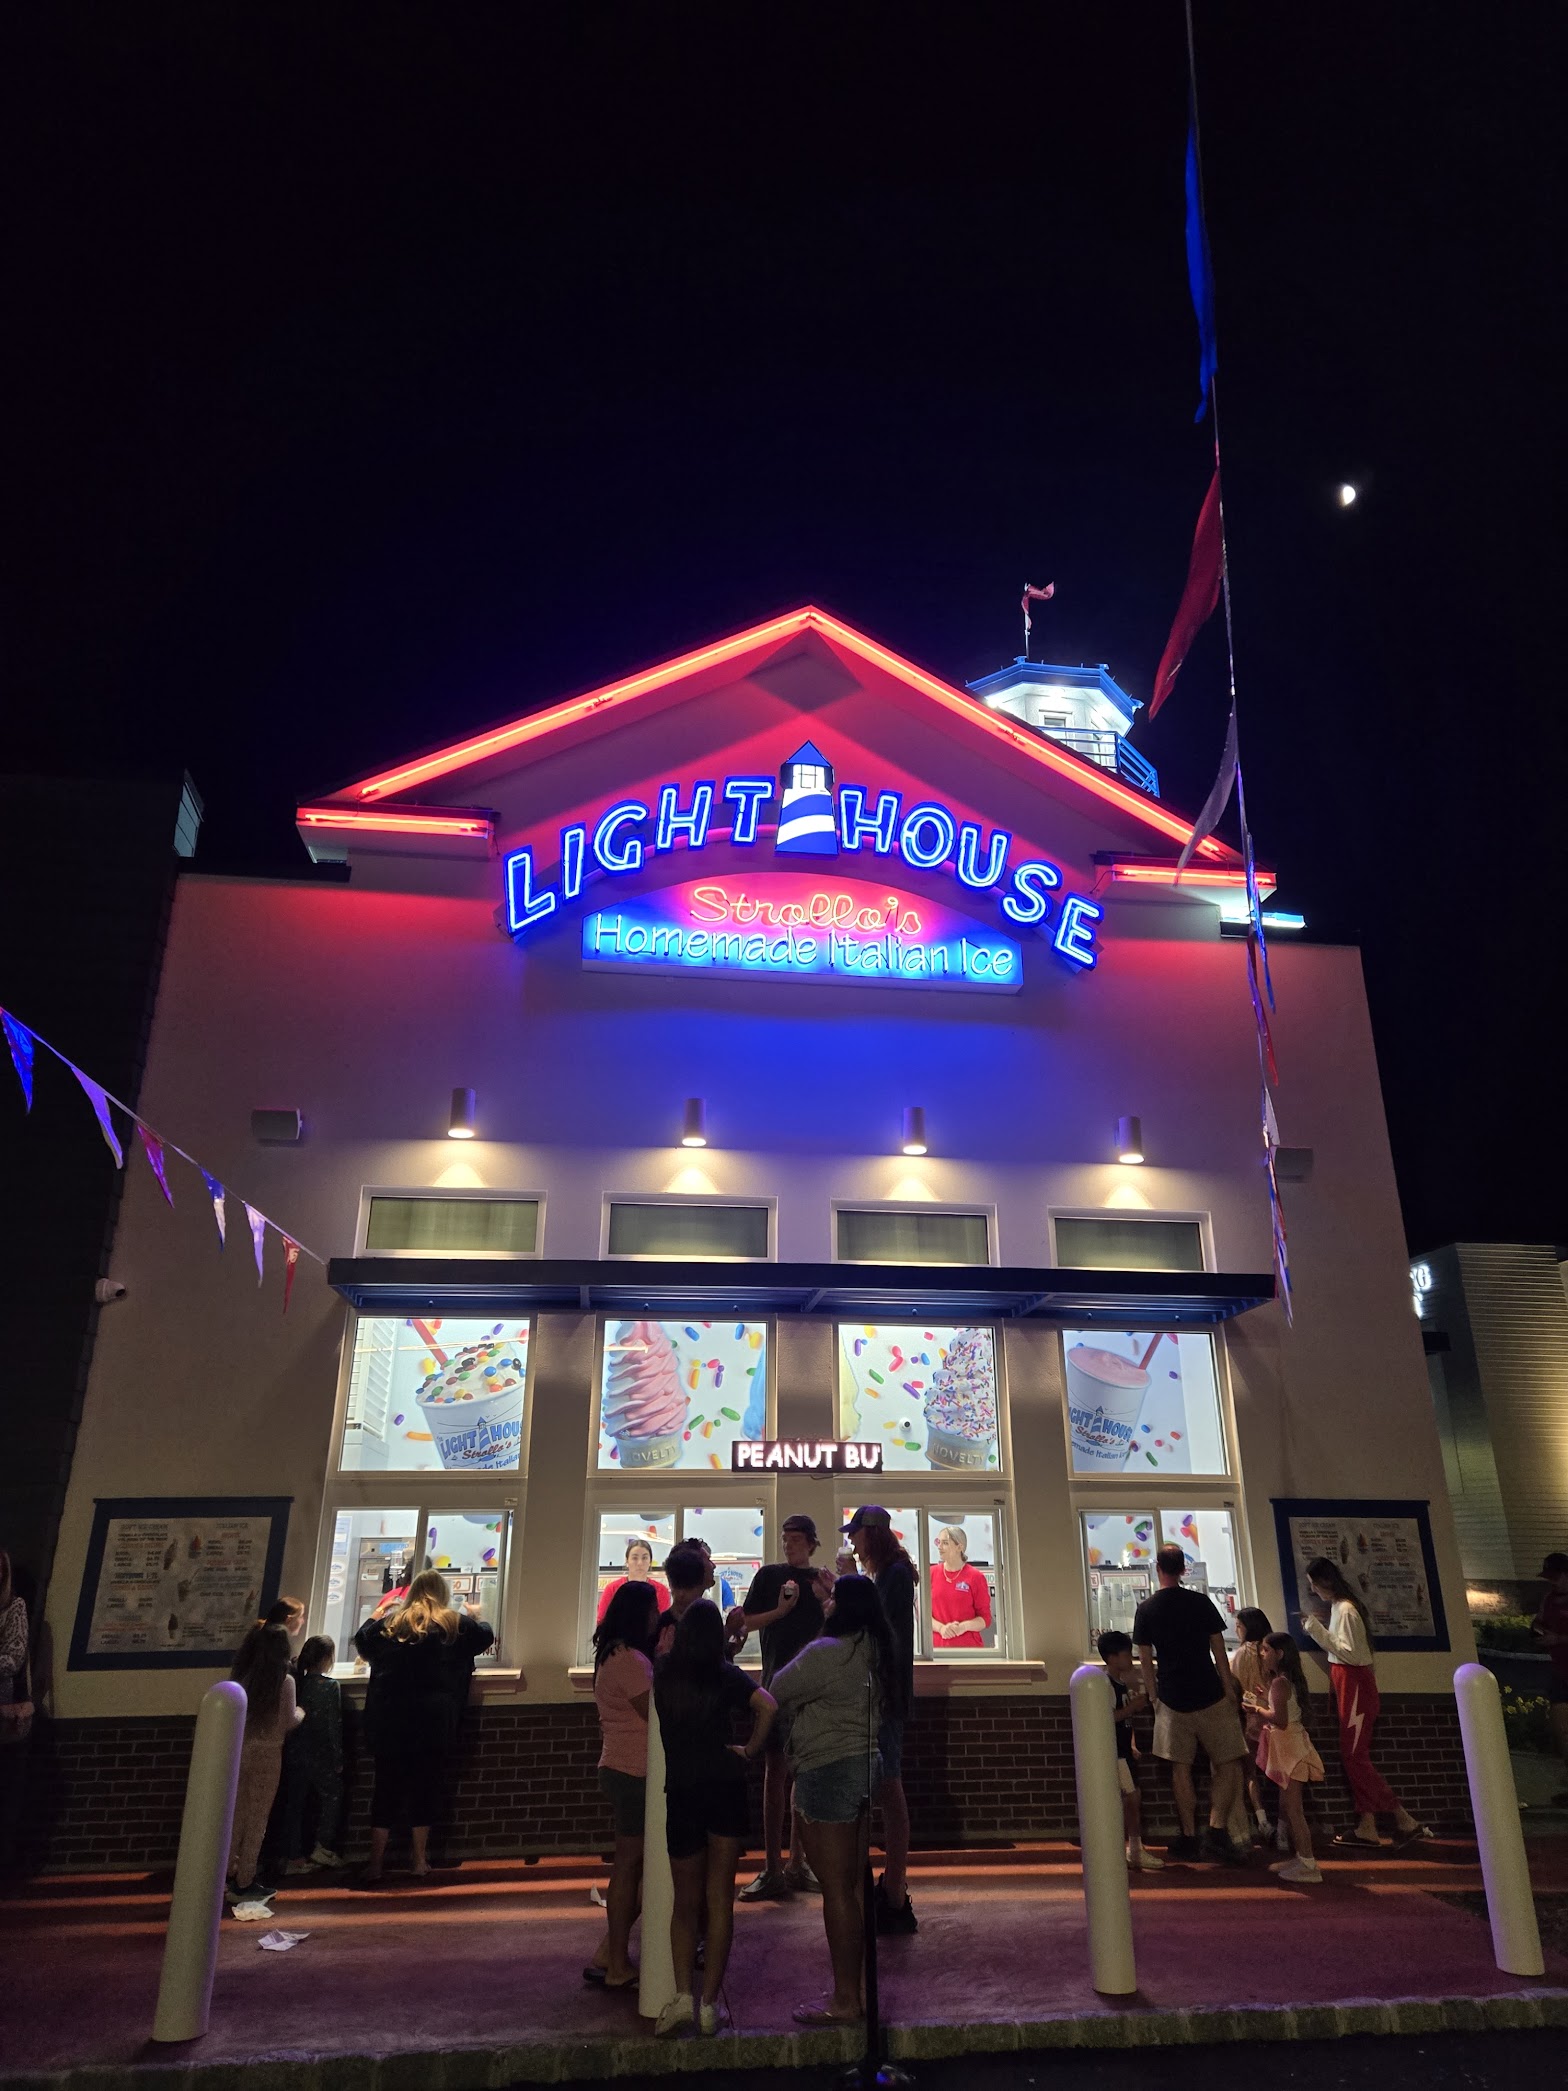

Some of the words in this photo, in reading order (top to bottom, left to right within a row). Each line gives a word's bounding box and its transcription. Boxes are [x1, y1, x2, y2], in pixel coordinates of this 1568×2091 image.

[503, 775, 776, 935] LIGHT
[837, 783, 1104, 970] HOUSE
[689, 886, 922, 936] Strollo's
[593, 911, 819, 966] Homemade
[828, 930, 949, 974] Italian
[959, 938, 1014, 978] Ice
[440, 1430, 477, 1460] LIGHT
[461, 1440, 512, 1460] Strollo's
[737, 1443, 838, 1468] PEANUT
